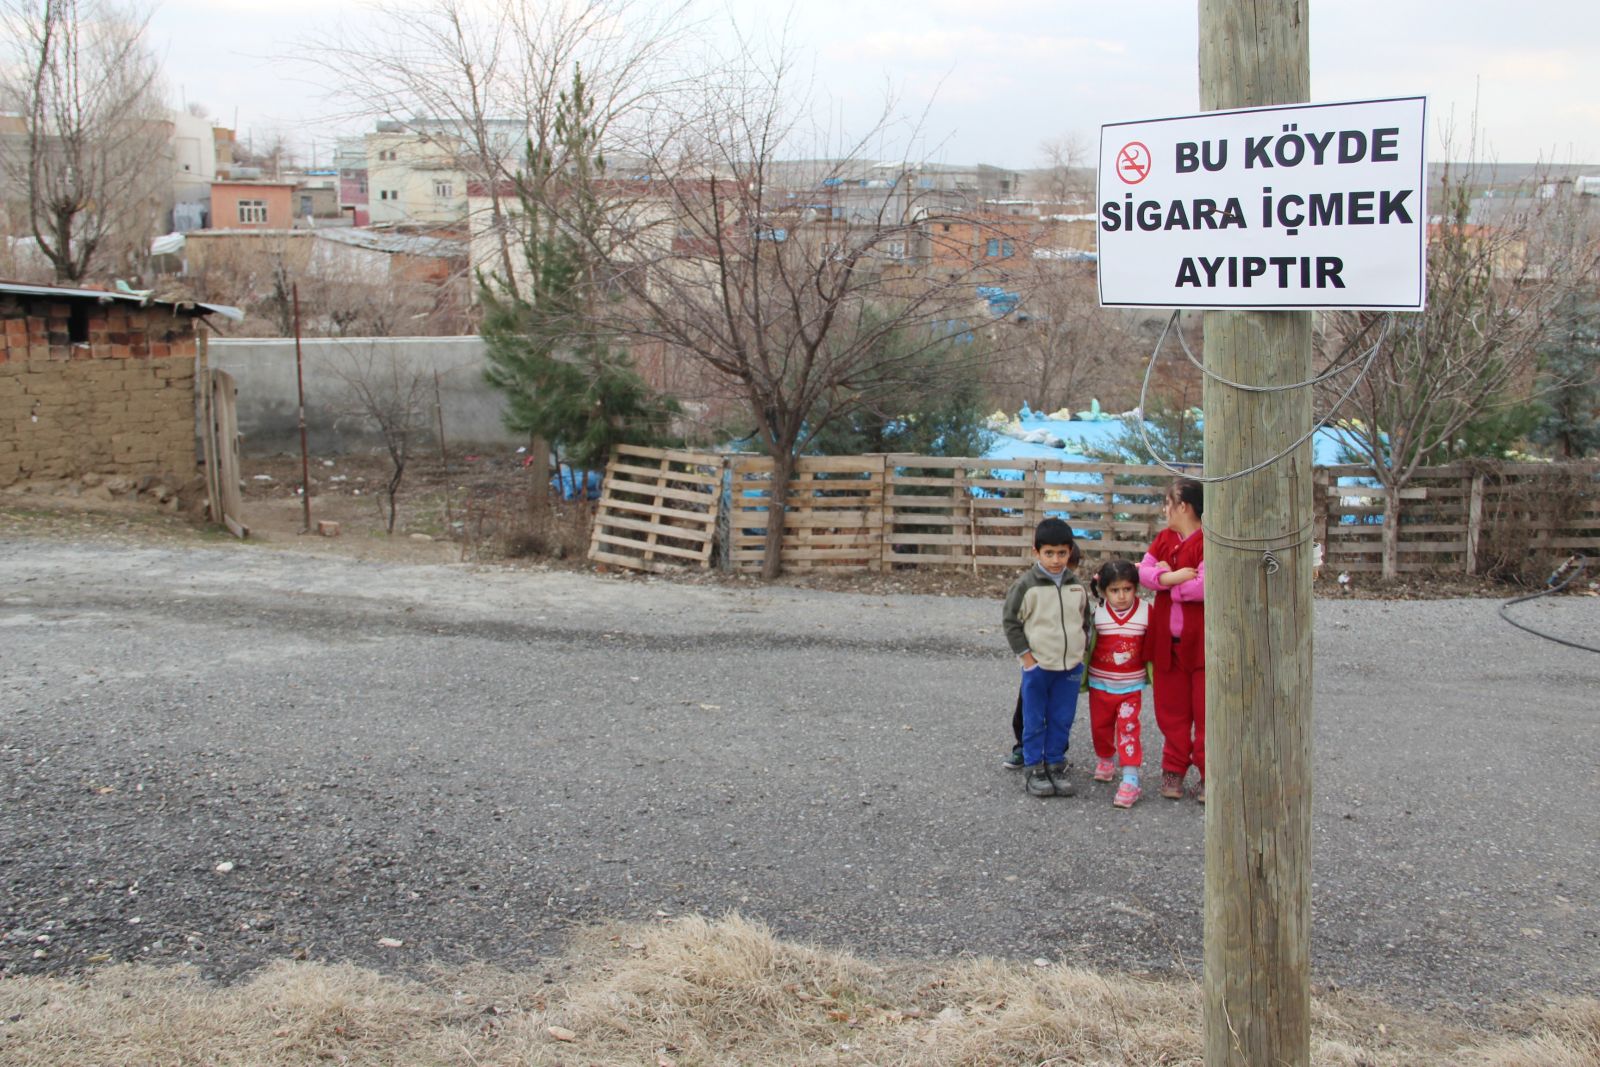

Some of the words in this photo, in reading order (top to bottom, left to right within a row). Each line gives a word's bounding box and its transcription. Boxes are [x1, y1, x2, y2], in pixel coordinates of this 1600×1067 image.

[1175, 140, 1228, 174] BU
[1244, 124, 1399, 169] KÖYDE
[1101, 192, 1248, 232] SİGARA
[1262, 187, 1414, 236] İÇMEK
[1174, 256, 1346, 289] AYIPTIR
